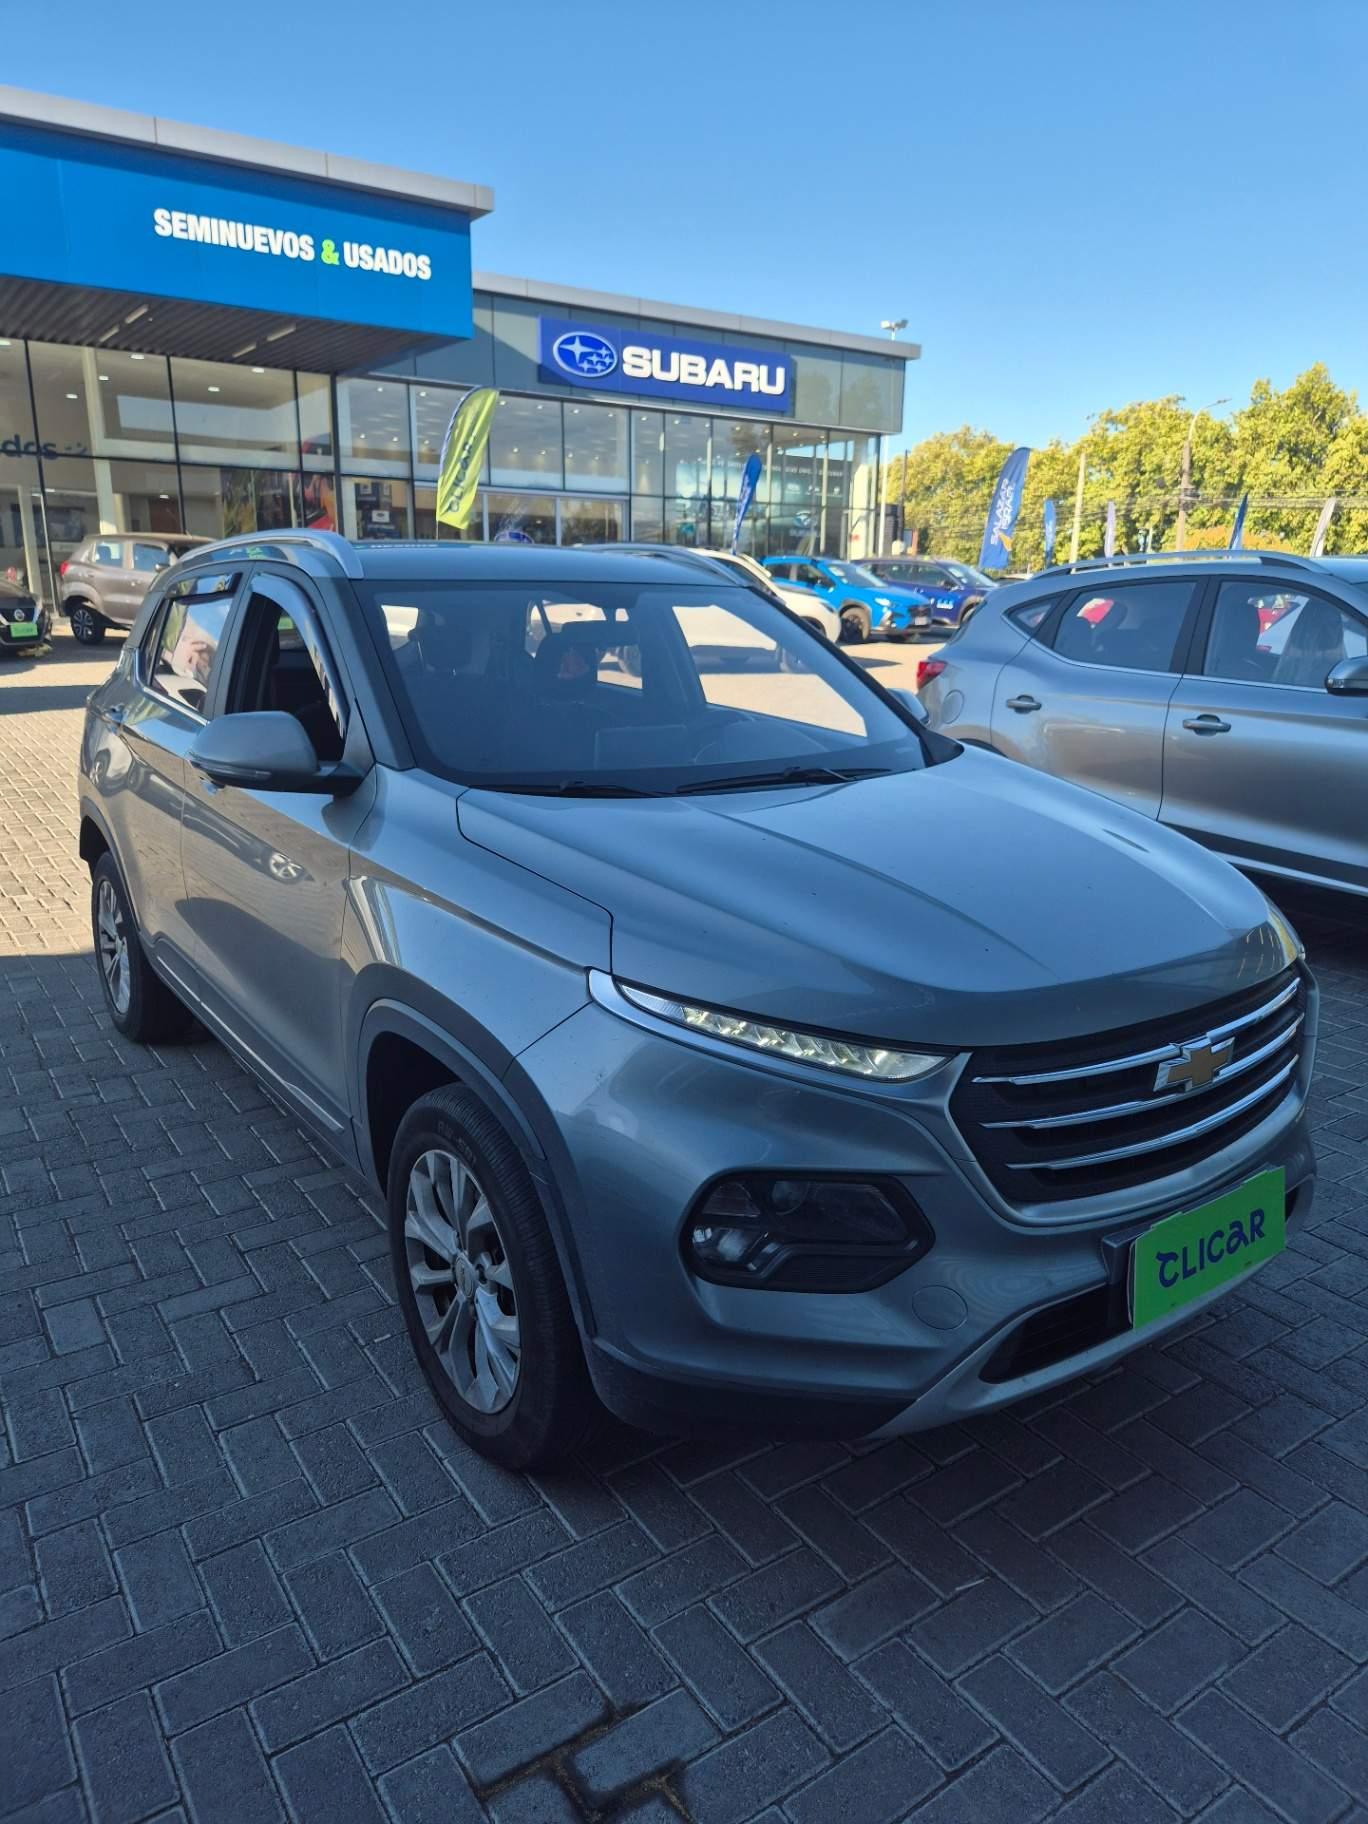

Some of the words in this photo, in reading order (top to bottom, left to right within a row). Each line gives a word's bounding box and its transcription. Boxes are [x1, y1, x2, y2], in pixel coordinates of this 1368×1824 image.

[153, 207, 315, 261] SEMINUEVOS
[320, 238, 340, 266] &
[342, 241, 432, 280] USADOS
[622, 345, 786, 396] SUBARU
